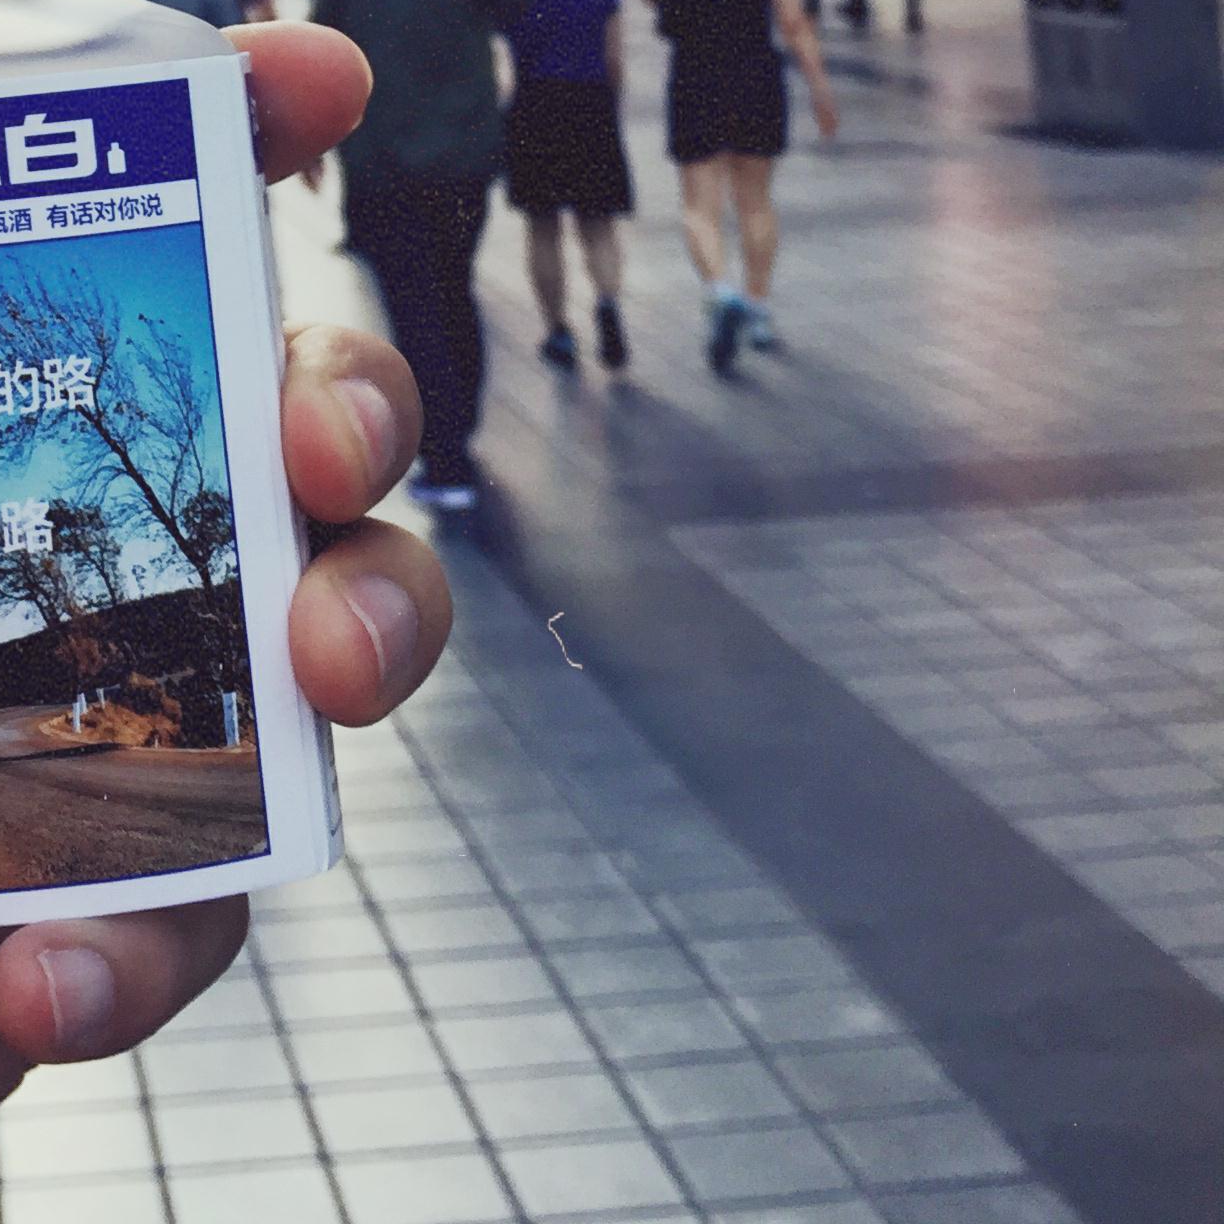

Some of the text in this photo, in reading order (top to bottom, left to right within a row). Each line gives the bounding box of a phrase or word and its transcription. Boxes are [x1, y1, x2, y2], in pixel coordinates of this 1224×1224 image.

[46, 192, 164, 229] 有话对你说
